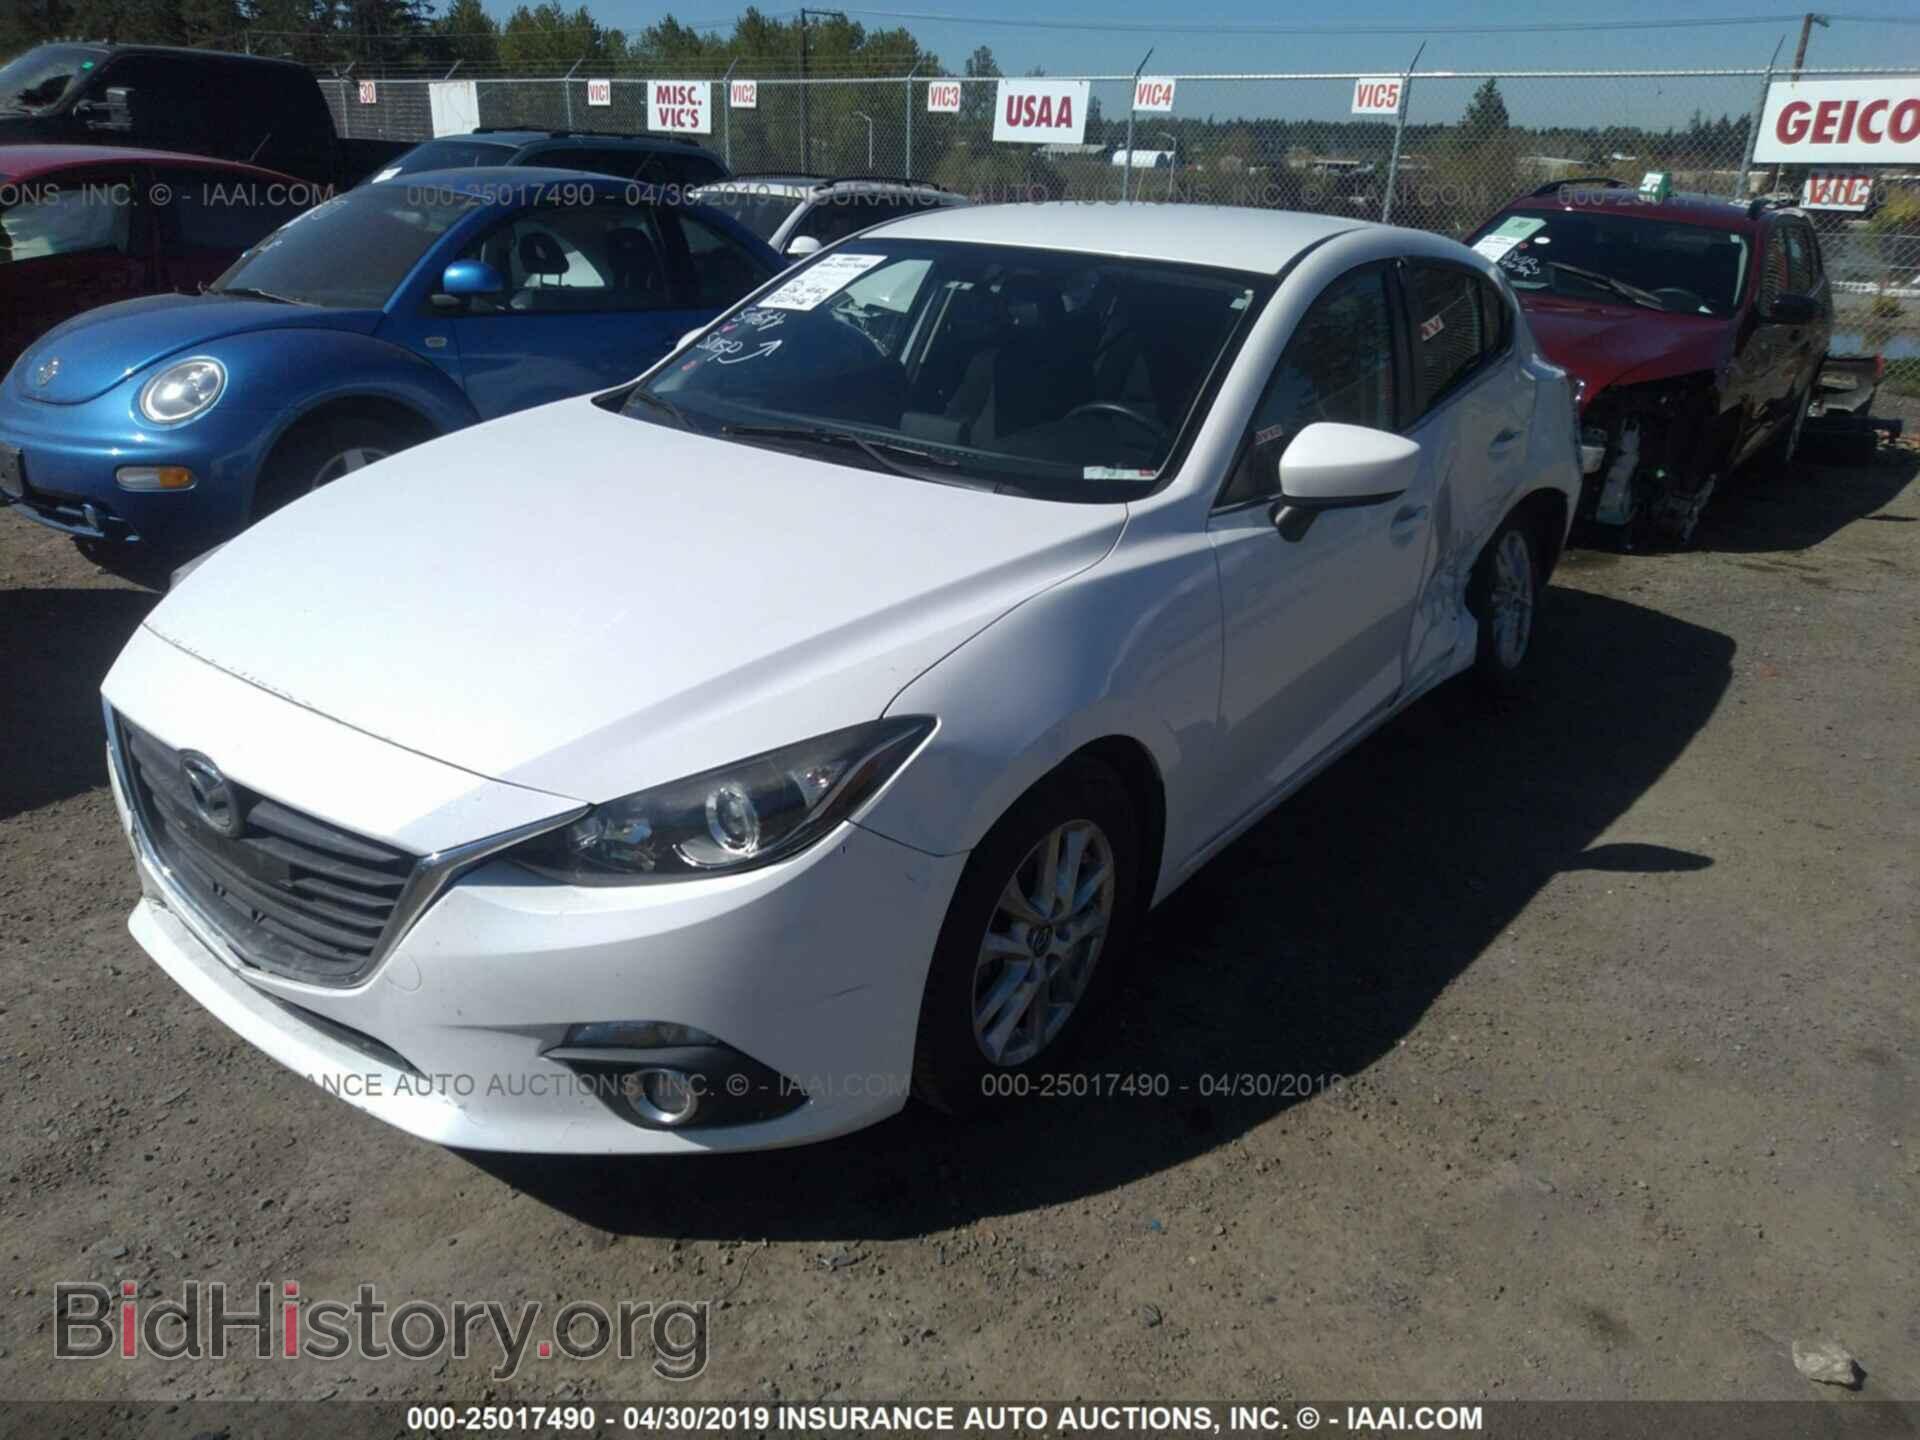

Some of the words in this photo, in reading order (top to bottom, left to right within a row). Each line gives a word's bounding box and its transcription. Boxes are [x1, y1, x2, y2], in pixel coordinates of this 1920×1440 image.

[361, 84, 375, 103] 30
[590, 84, 609, 102] VIC1
[656, 85, 703, 106] MISC.
[733, 84, 755, 103] VIC2
[931, 86, 960, 107] VIC3
[1136, 83, 1172, 106] VIC4
[1357, 83, 1399, 108] VIC5
[659, 107, 699, 128] VIC'S
[1006, 95, 1073, 129] USAA
[1776, 98, 1920, 145] GEICO
